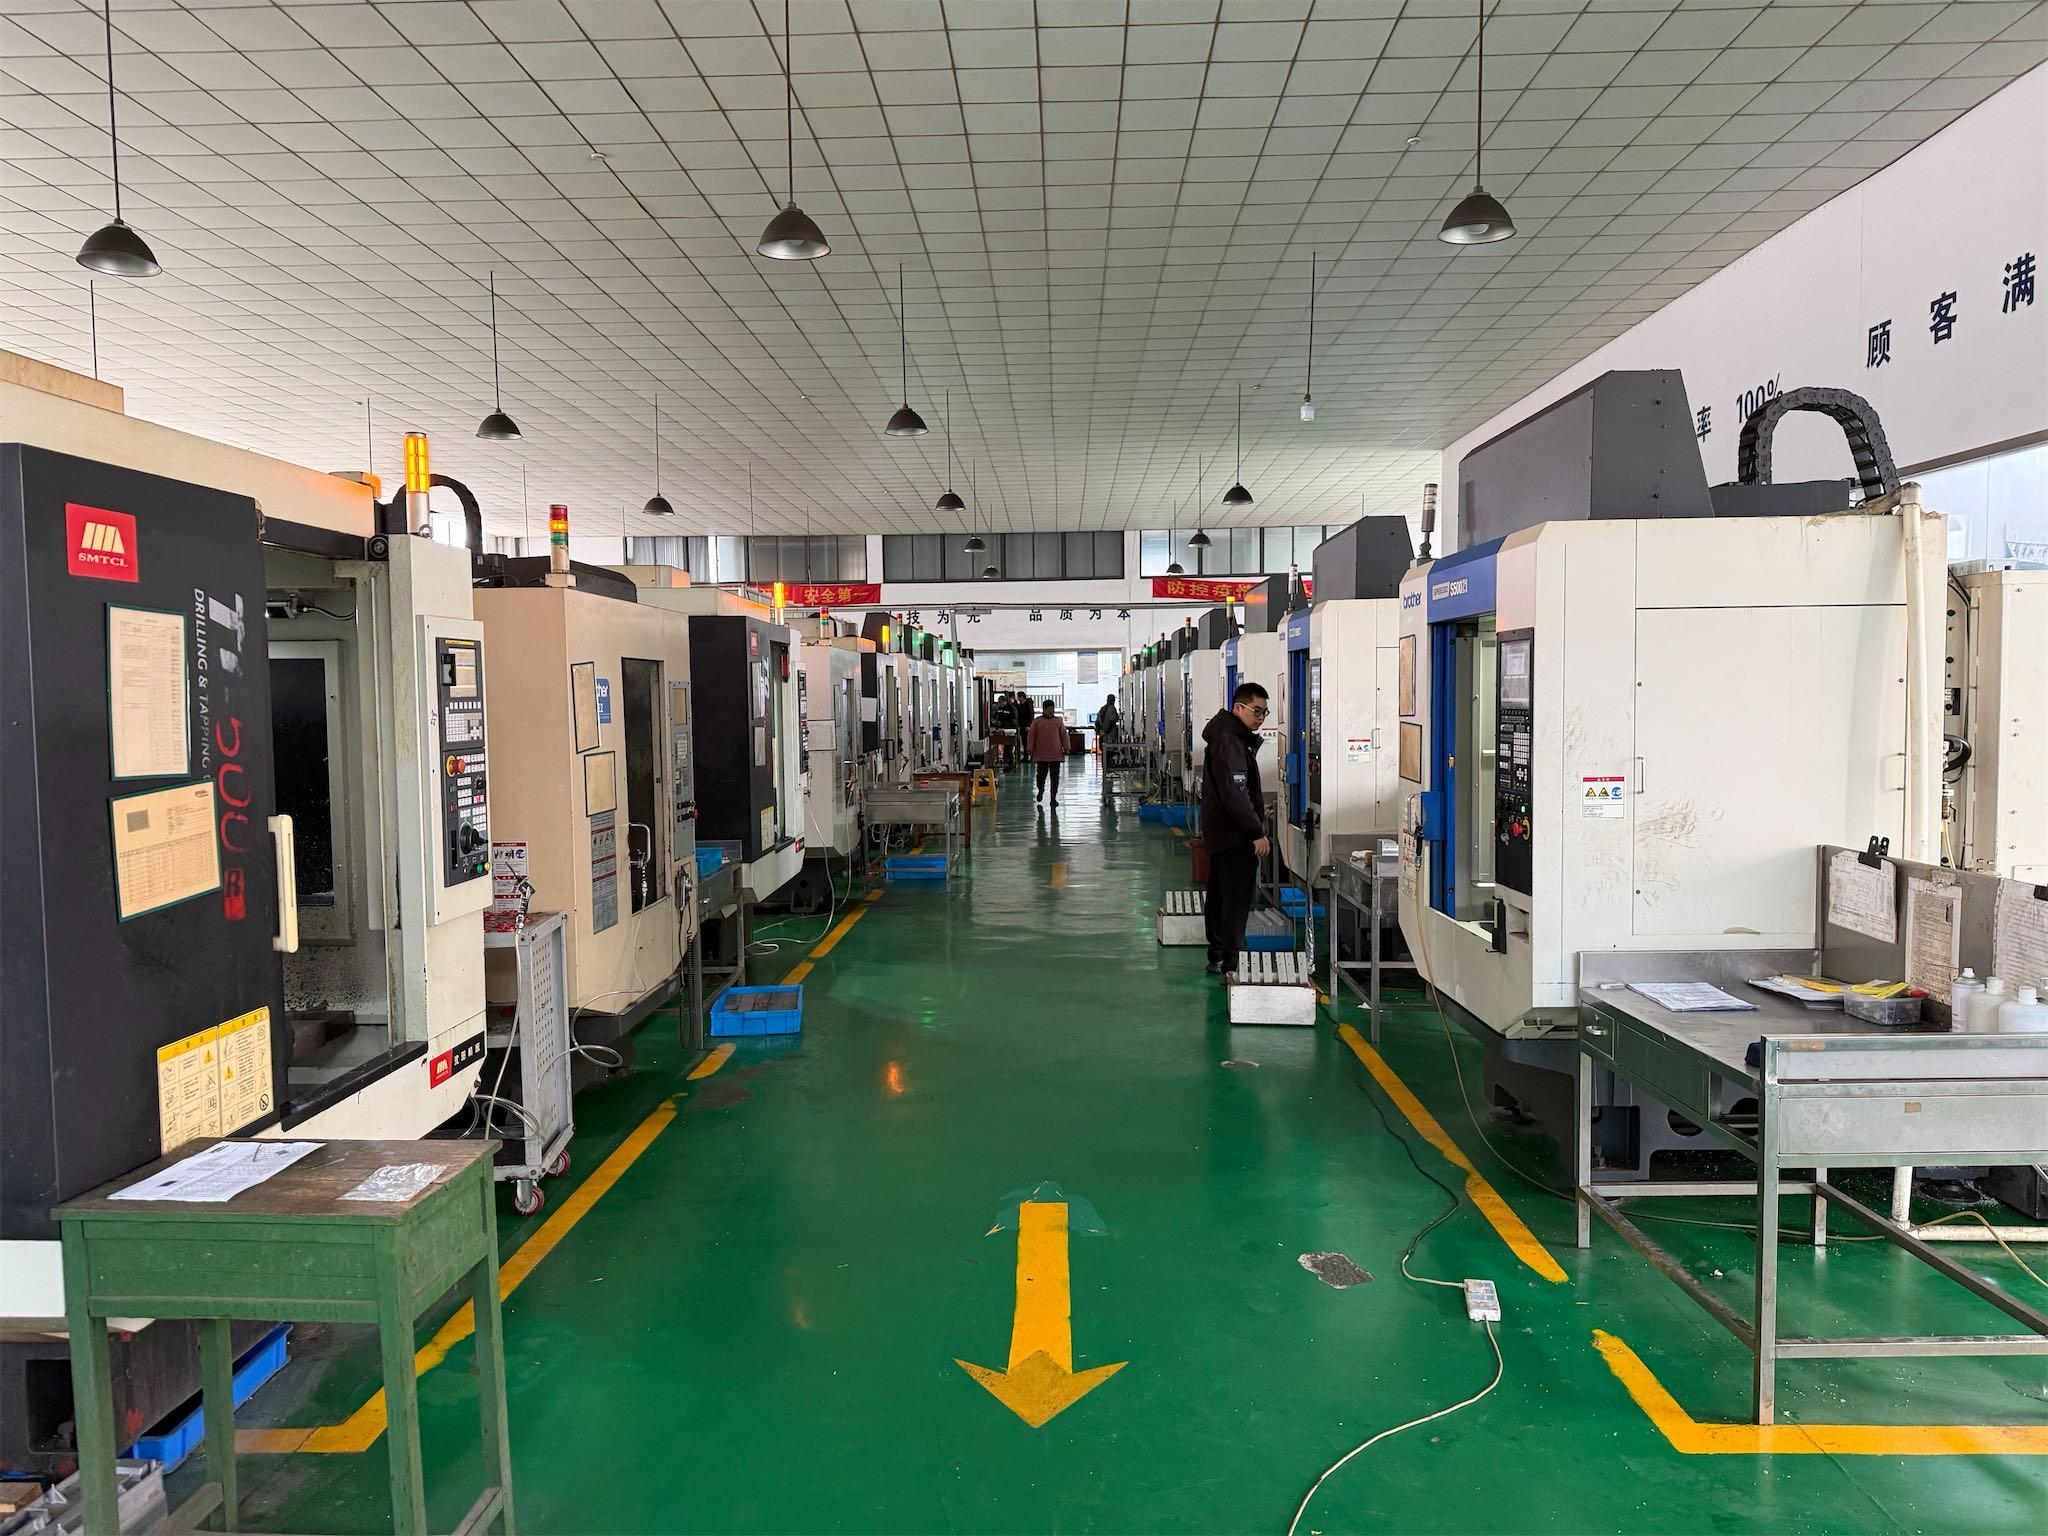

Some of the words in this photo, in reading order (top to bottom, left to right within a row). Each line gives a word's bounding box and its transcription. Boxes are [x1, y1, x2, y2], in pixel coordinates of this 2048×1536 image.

[78, 552, 129, 567] SMTCL
[194, 587, 209, 671] DRILLING
[198, 674, 208, 689] &
[199, 694, 212, 769] TAPPING
